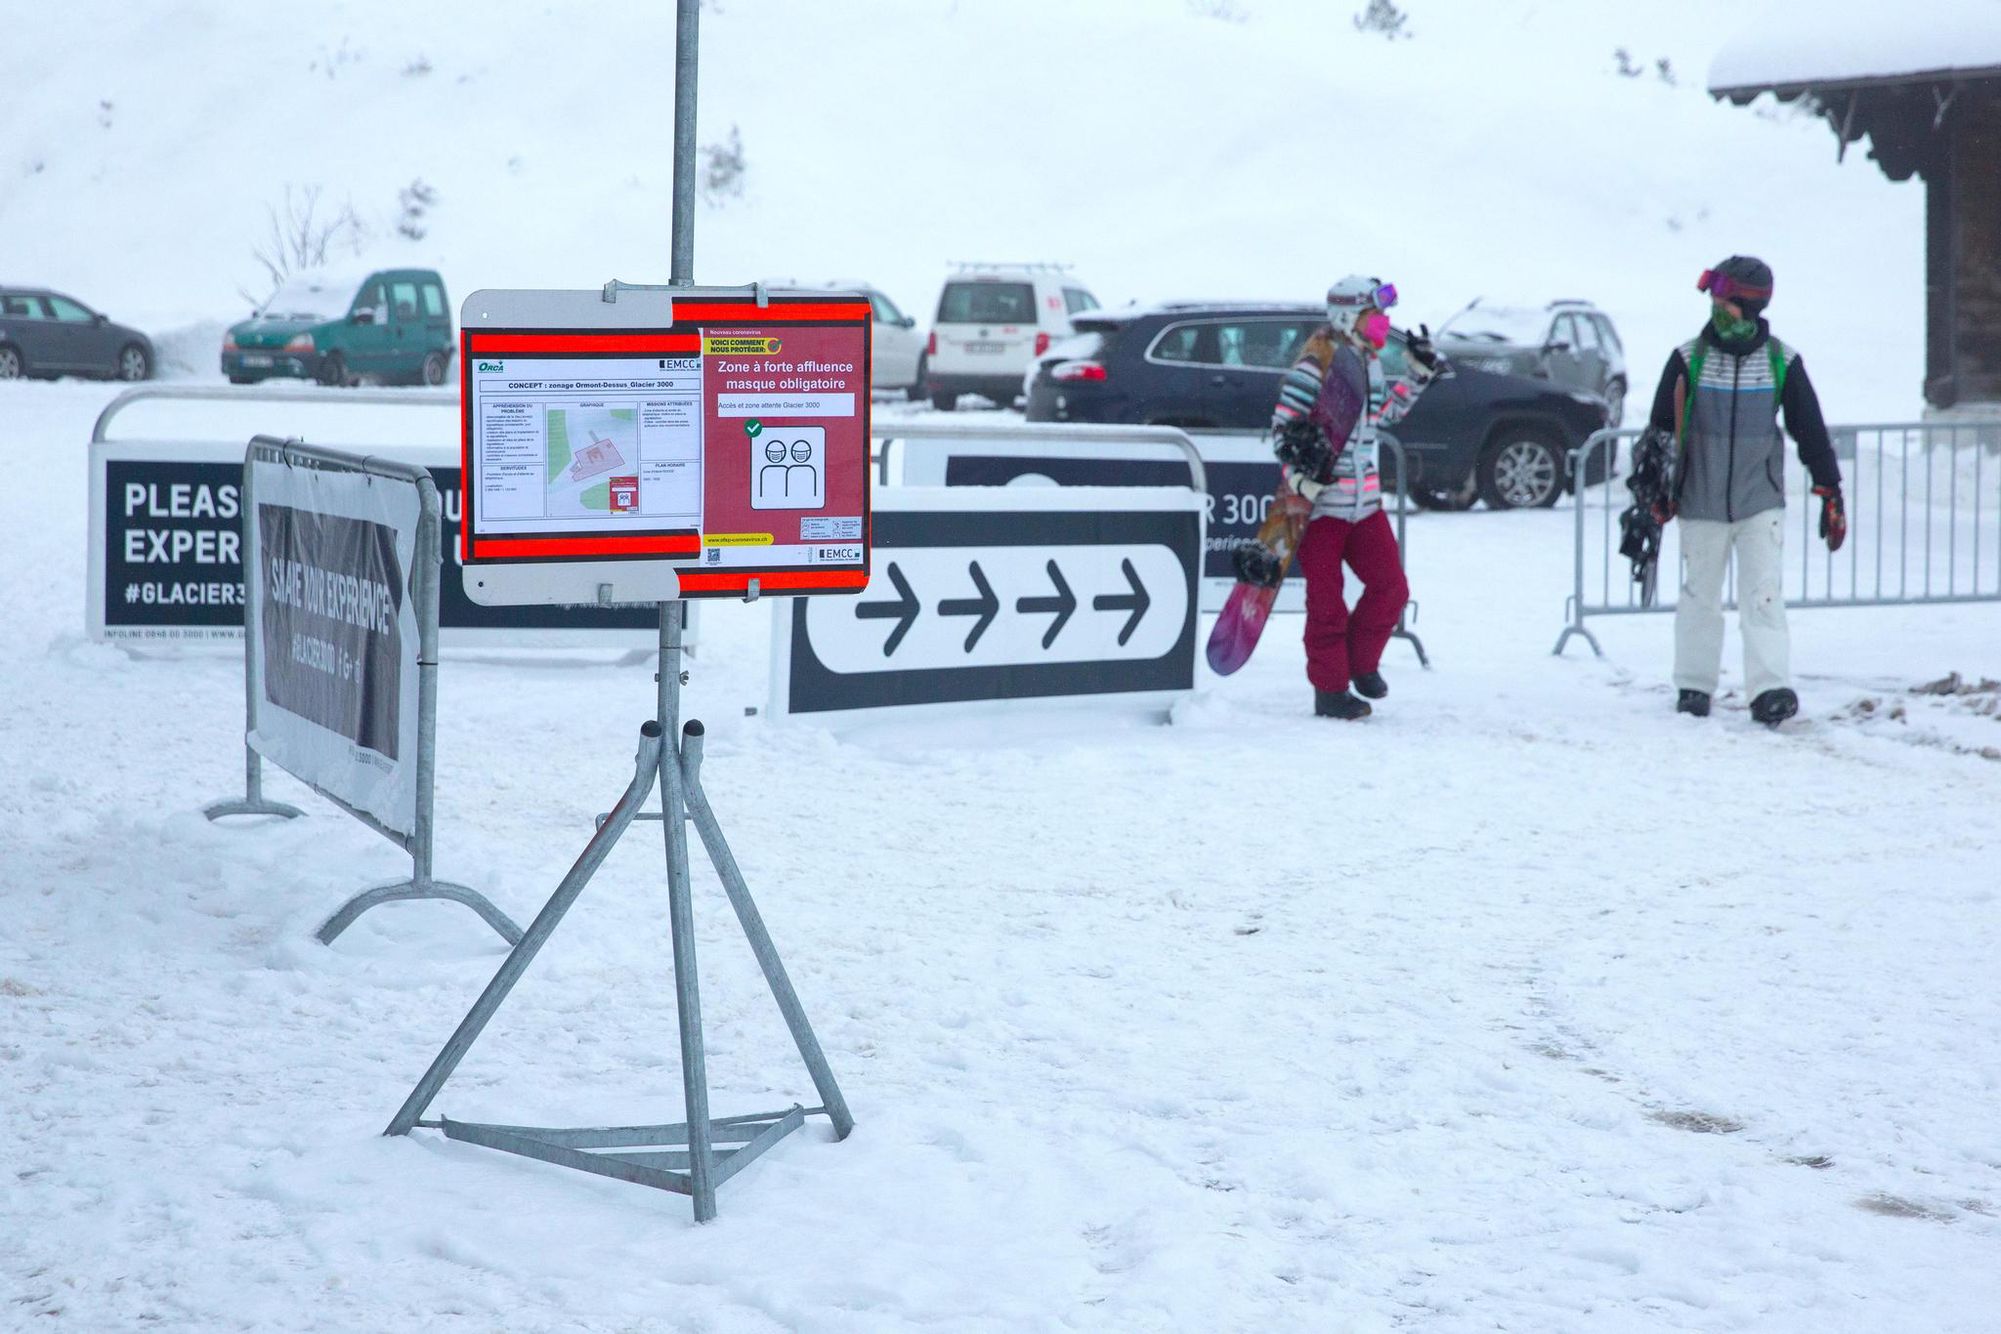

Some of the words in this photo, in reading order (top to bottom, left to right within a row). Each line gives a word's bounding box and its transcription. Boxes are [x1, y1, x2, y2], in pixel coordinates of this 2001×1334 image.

[666, 360, 695, 369] EMCC
[718, 361, 750, 372] Zone
[754, 360, 760, 372] à
[764, 361, 792, 372] forte
[797, 360, 854, 372] affluence
[726, 380, 776, 392] masque
[780, 378, 846, 392] obligatoire
[125, 483, 244, 518] PLEAS
[1223, 494, 1276, 524] 300
[124, 529, 241, 564] EXPER
[826, 548, 853, 558] EMCC
[125, 582, 245, 604] #GLACIER3
[327, 571, 390, 636] EXPERIENCE
